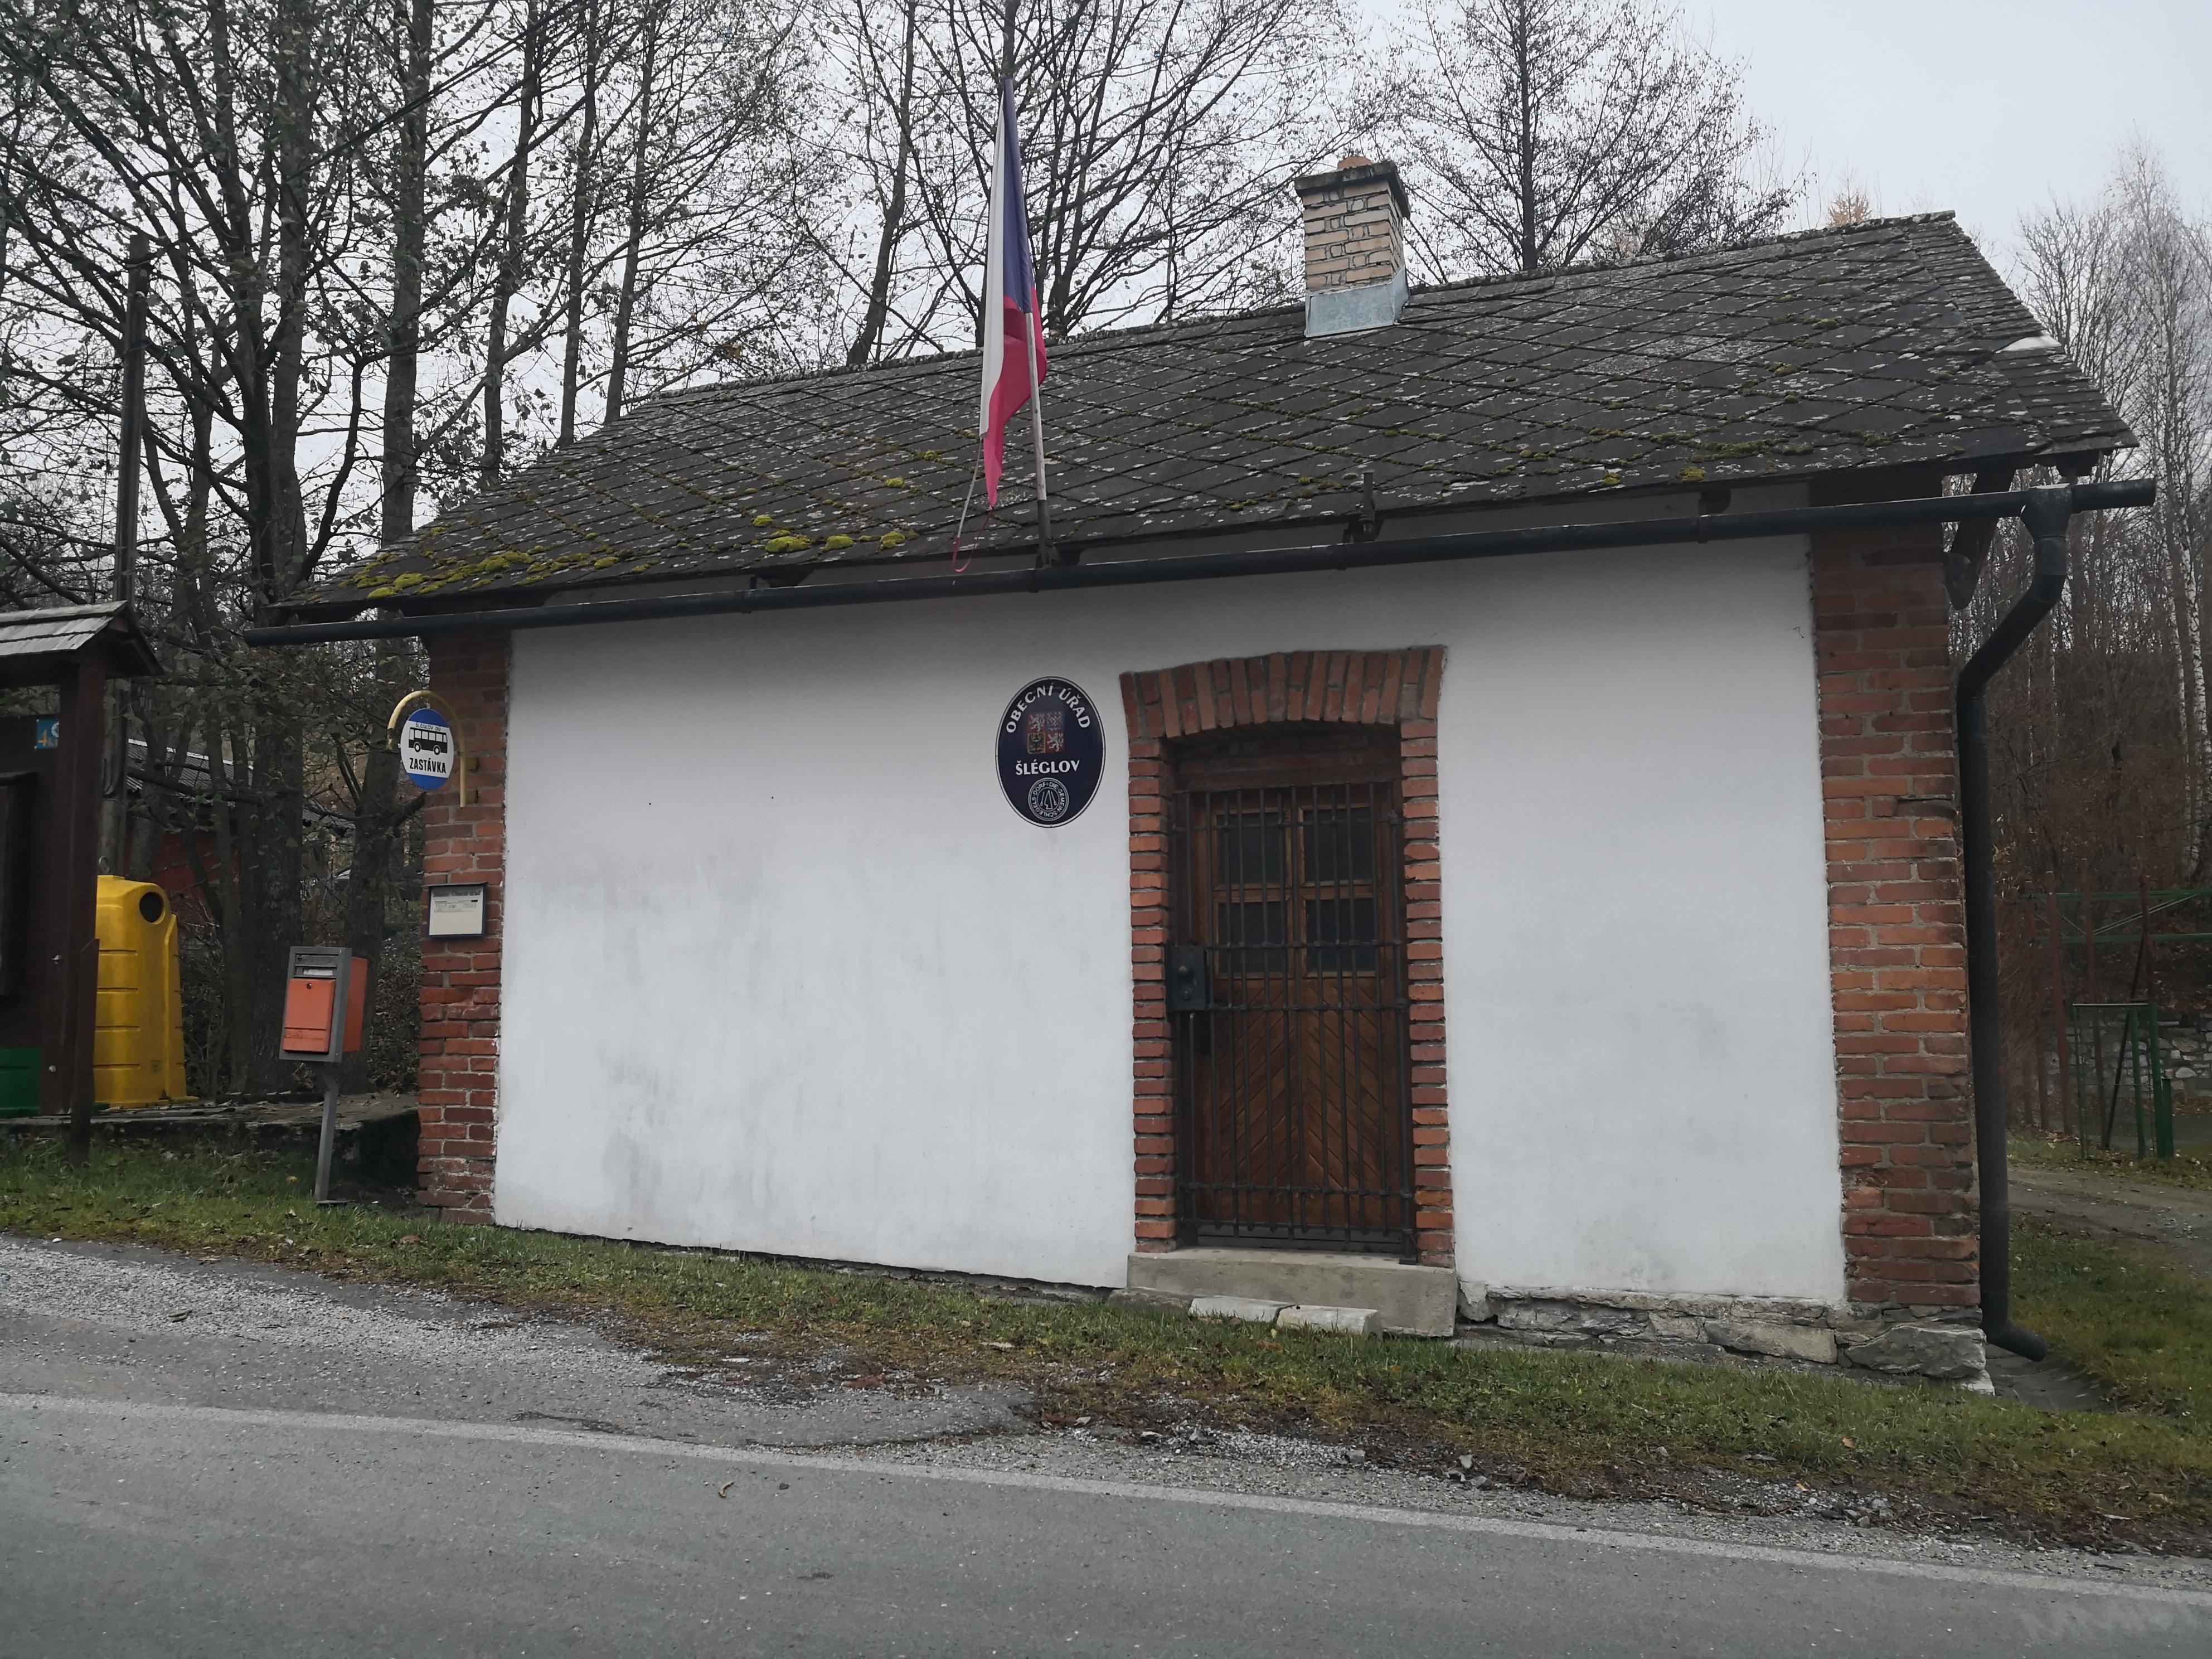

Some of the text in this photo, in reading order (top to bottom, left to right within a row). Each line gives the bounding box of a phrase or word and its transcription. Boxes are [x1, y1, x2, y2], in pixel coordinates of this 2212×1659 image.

[1006, 683, 1090, 733] OBECNÍ ÚŘAD
[410, 758, 446, 774] ZASTÁVKA
[1015, 759, 1080, 775] ŠLÉGLOV
